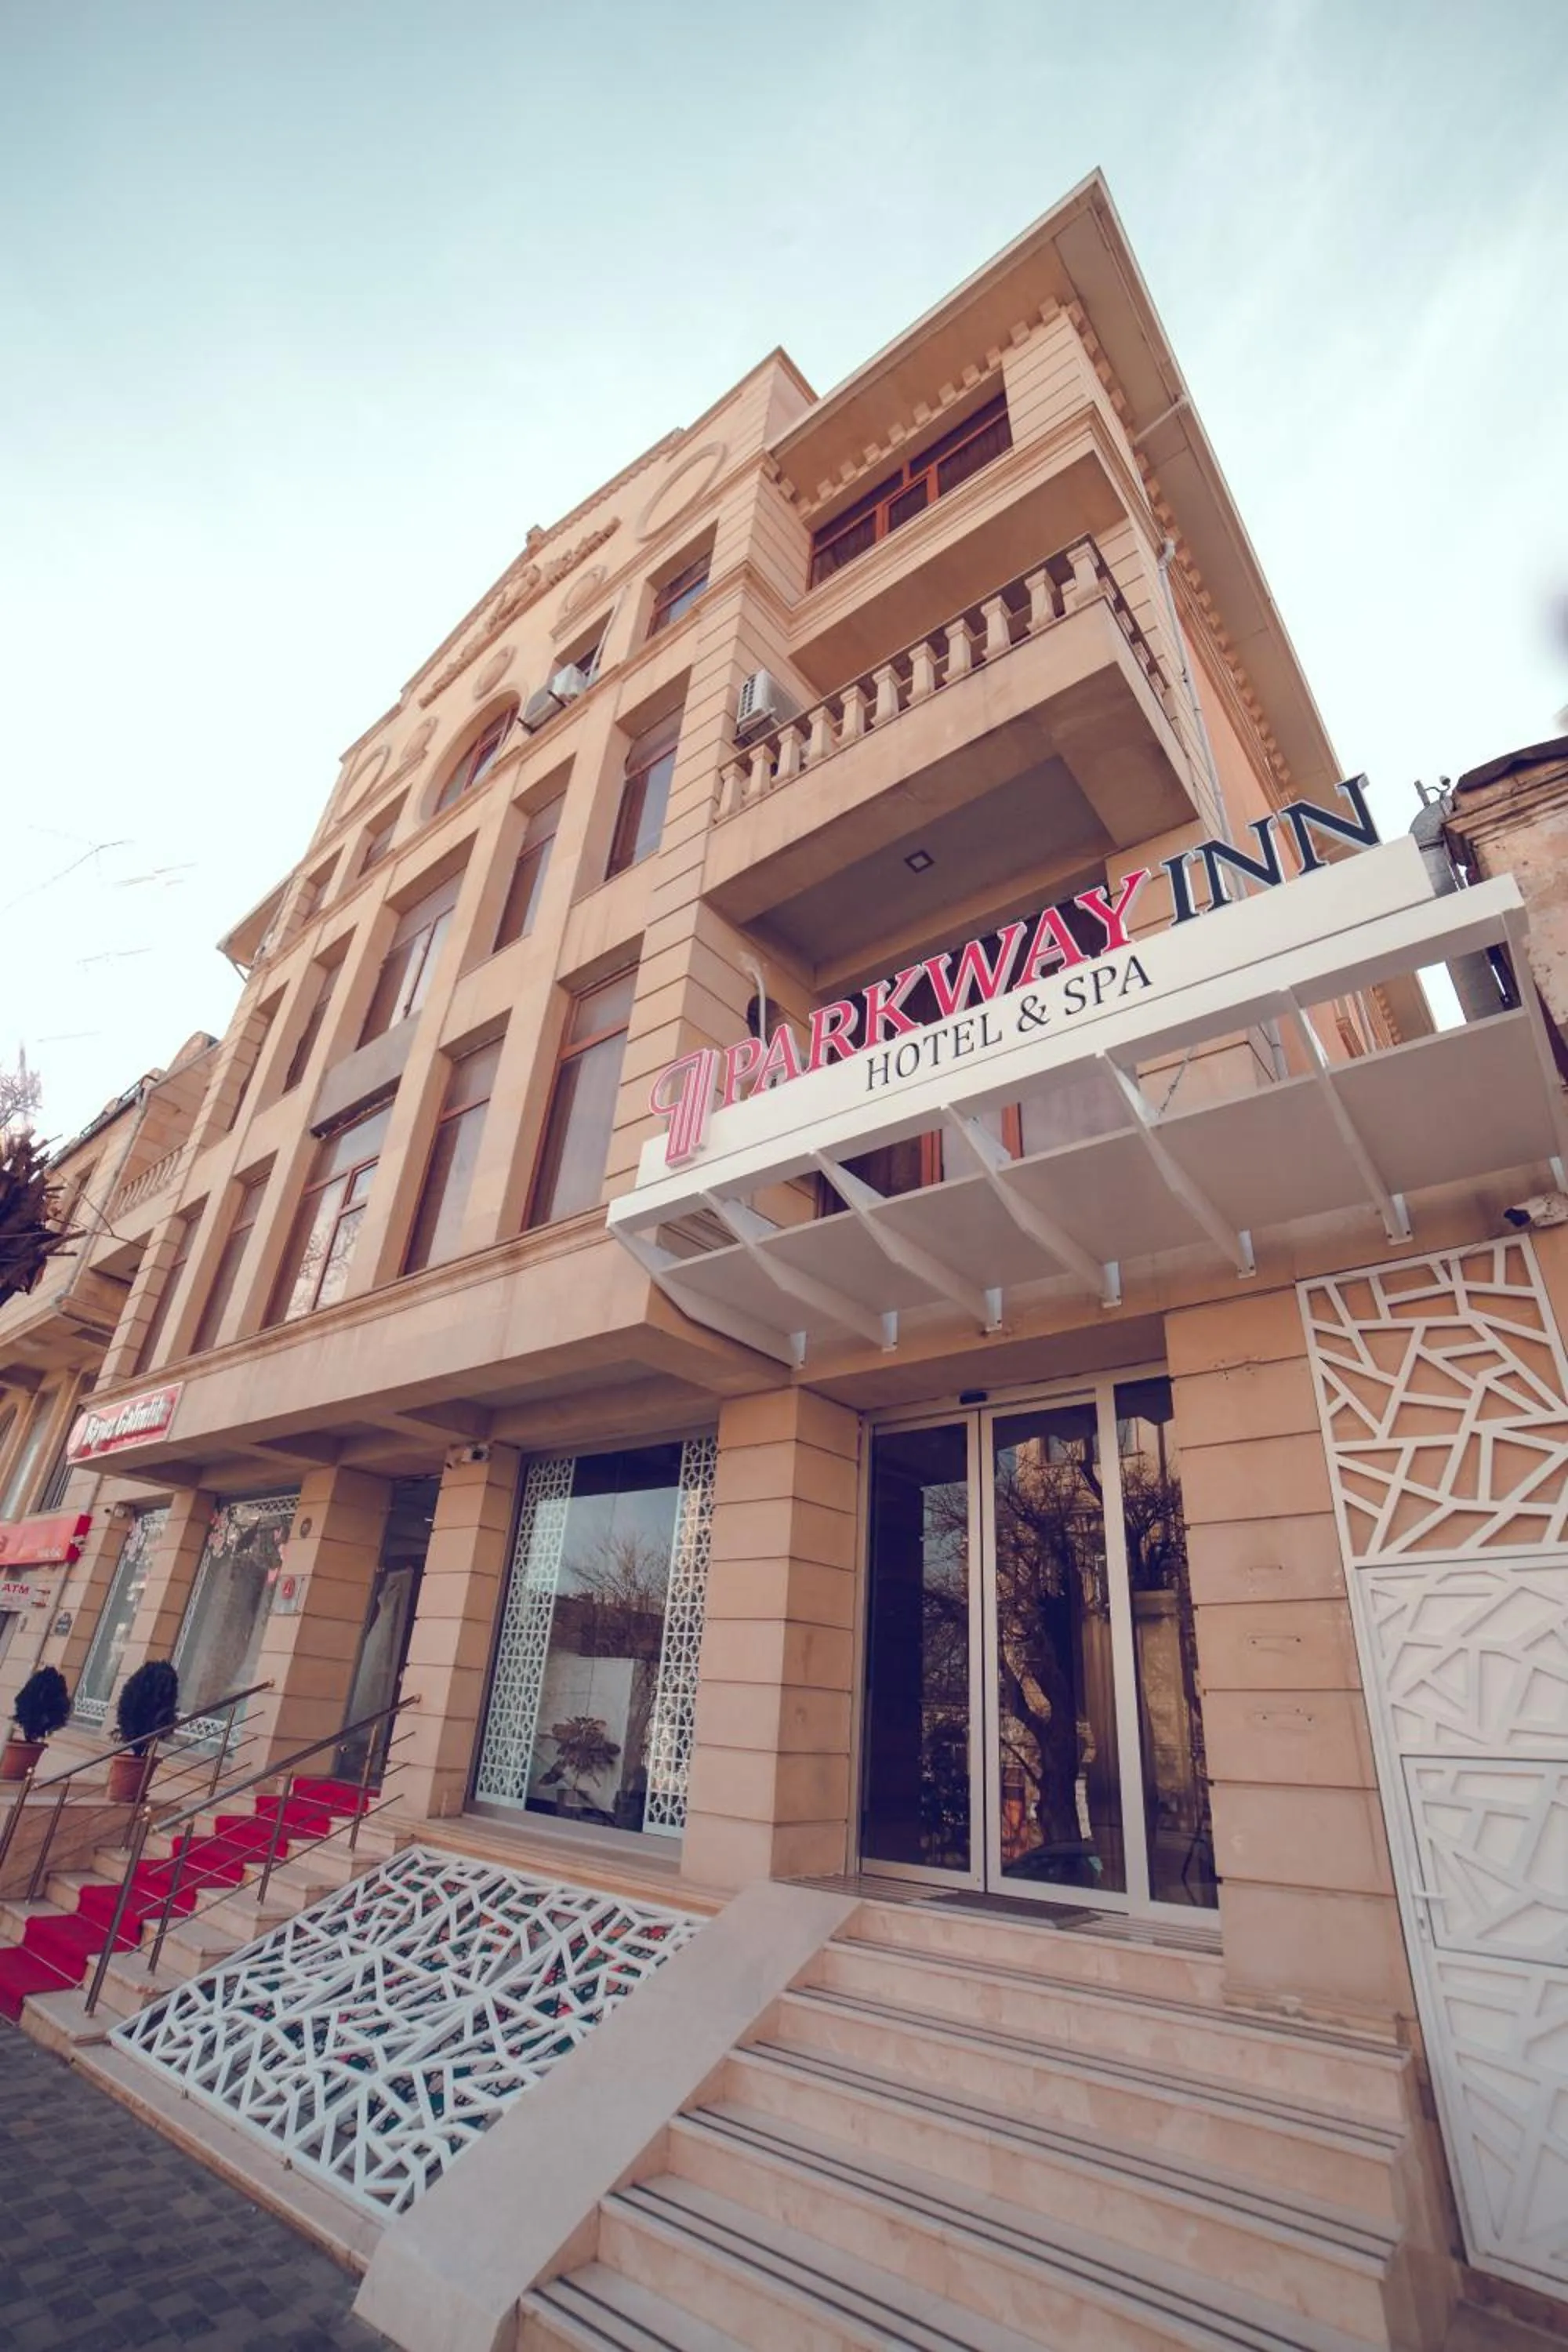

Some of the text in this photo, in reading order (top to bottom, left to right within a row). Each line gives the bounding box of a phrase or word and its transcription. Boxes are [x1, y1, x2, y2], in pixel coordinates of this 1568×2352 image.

[721, 771, 1383, 1107] PARKWAY INN
[866, 954, 1152, 1091] HOTEL & SPA
[2, 1582, 31, 1595] ATM
